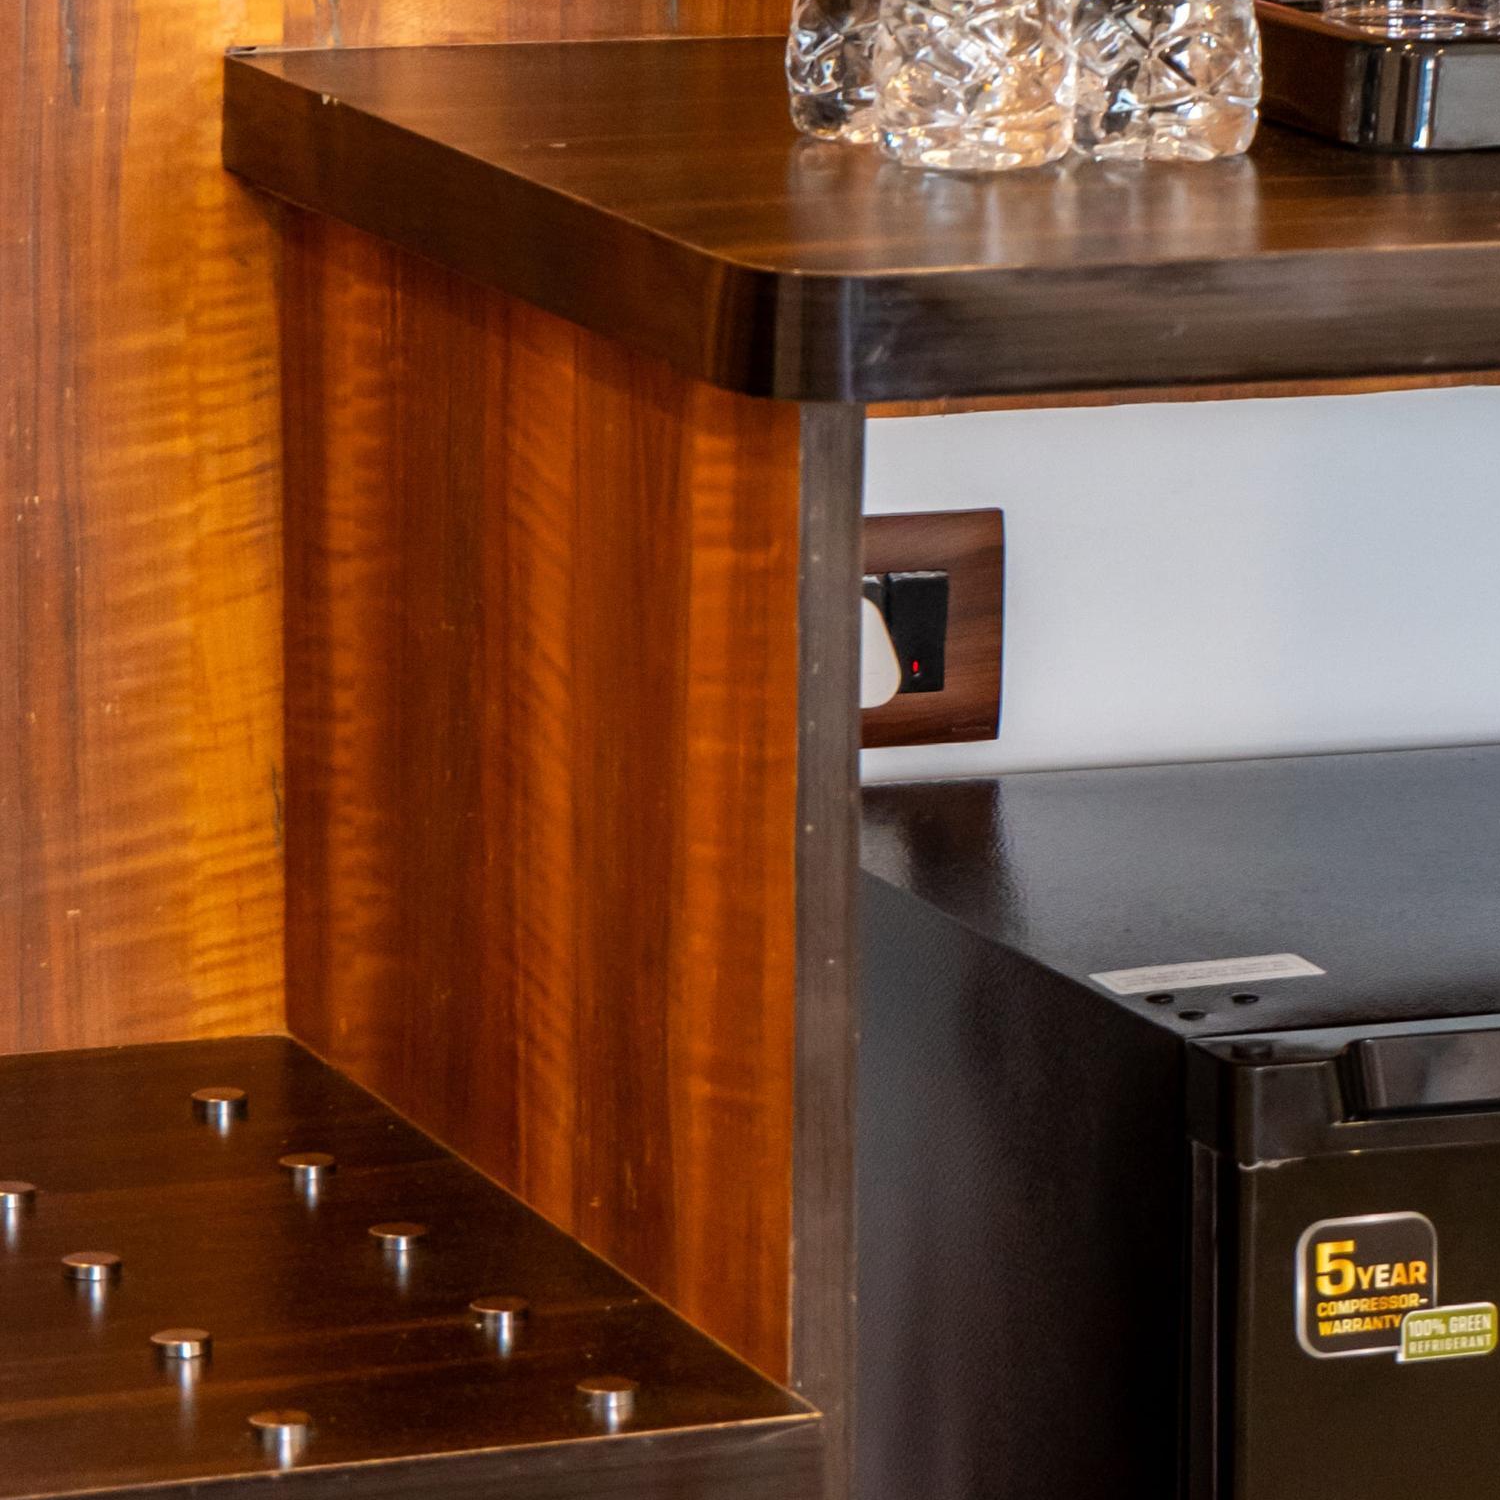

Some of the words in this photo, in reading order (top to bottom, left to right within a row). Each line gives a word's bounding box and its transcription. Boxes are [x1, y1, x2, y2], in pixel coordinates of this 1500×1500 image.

[1315, 1240, 1355, 1296] 5
[1356, 1261, 1427, 1290] YEAR
[1318, 1314, 1402, 1337] WARRANTY
[1409, 1318, 1446, 1338] 100%
[1449, 1313, 1492, 1333] GREEN
[1408, 1333, 1492, 1355] REFRIGERANT
